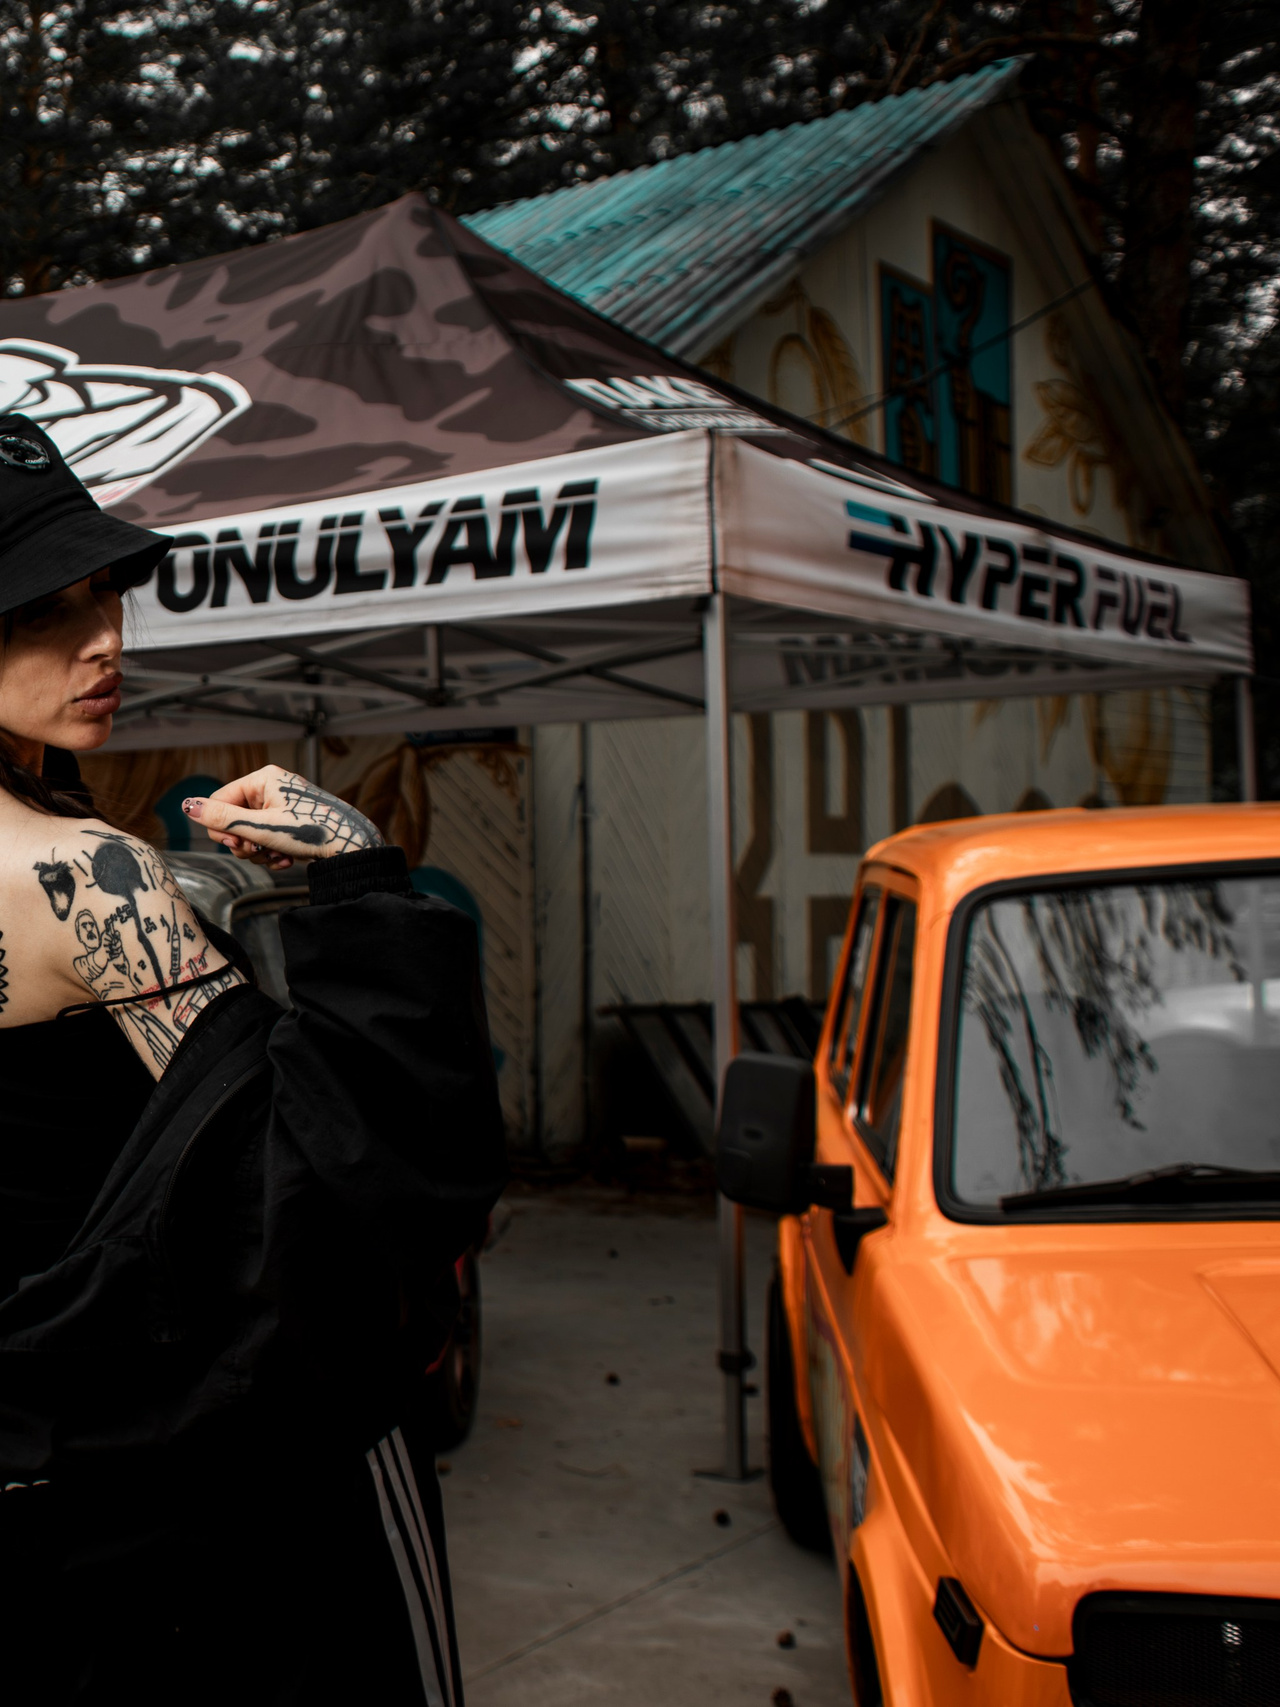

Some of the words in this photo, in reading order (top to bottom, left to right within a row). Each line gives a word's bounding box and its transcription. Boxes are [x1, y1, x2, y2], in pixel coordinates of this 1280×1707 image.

[132, 477, 599, 614] ONULYAM
[846, 500, 1087, 630] HYPER
[1092, 564, 1195, 644] FUEL
